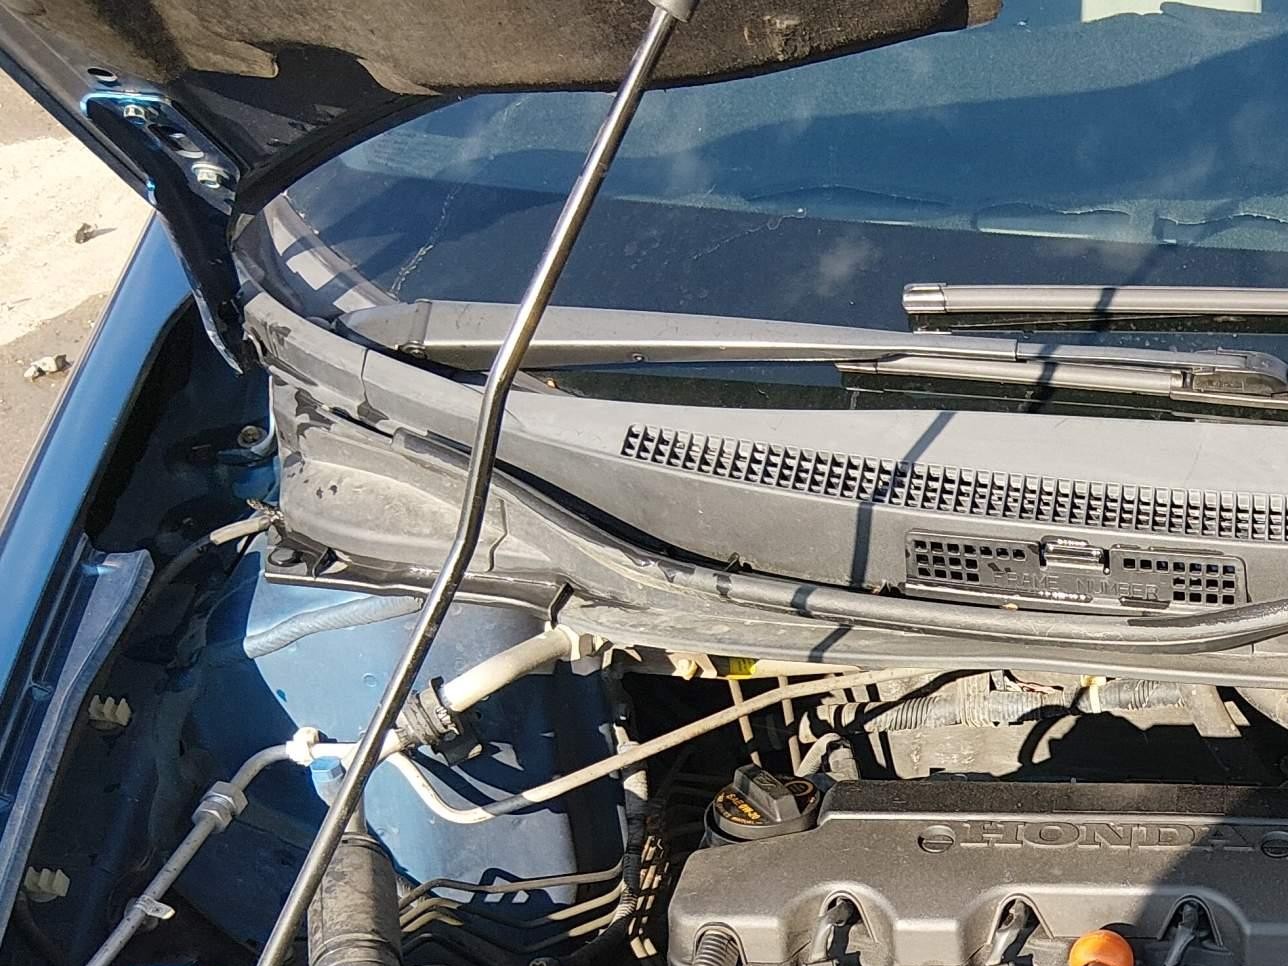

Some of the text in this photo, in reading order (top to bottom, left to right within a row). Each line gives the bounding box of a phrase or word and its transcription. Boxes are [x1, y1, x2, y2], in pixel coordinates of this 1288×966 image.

[993, 571, 1159, 600] FRAME NUMBER
[959, 821, 1254, 850] HONDA
